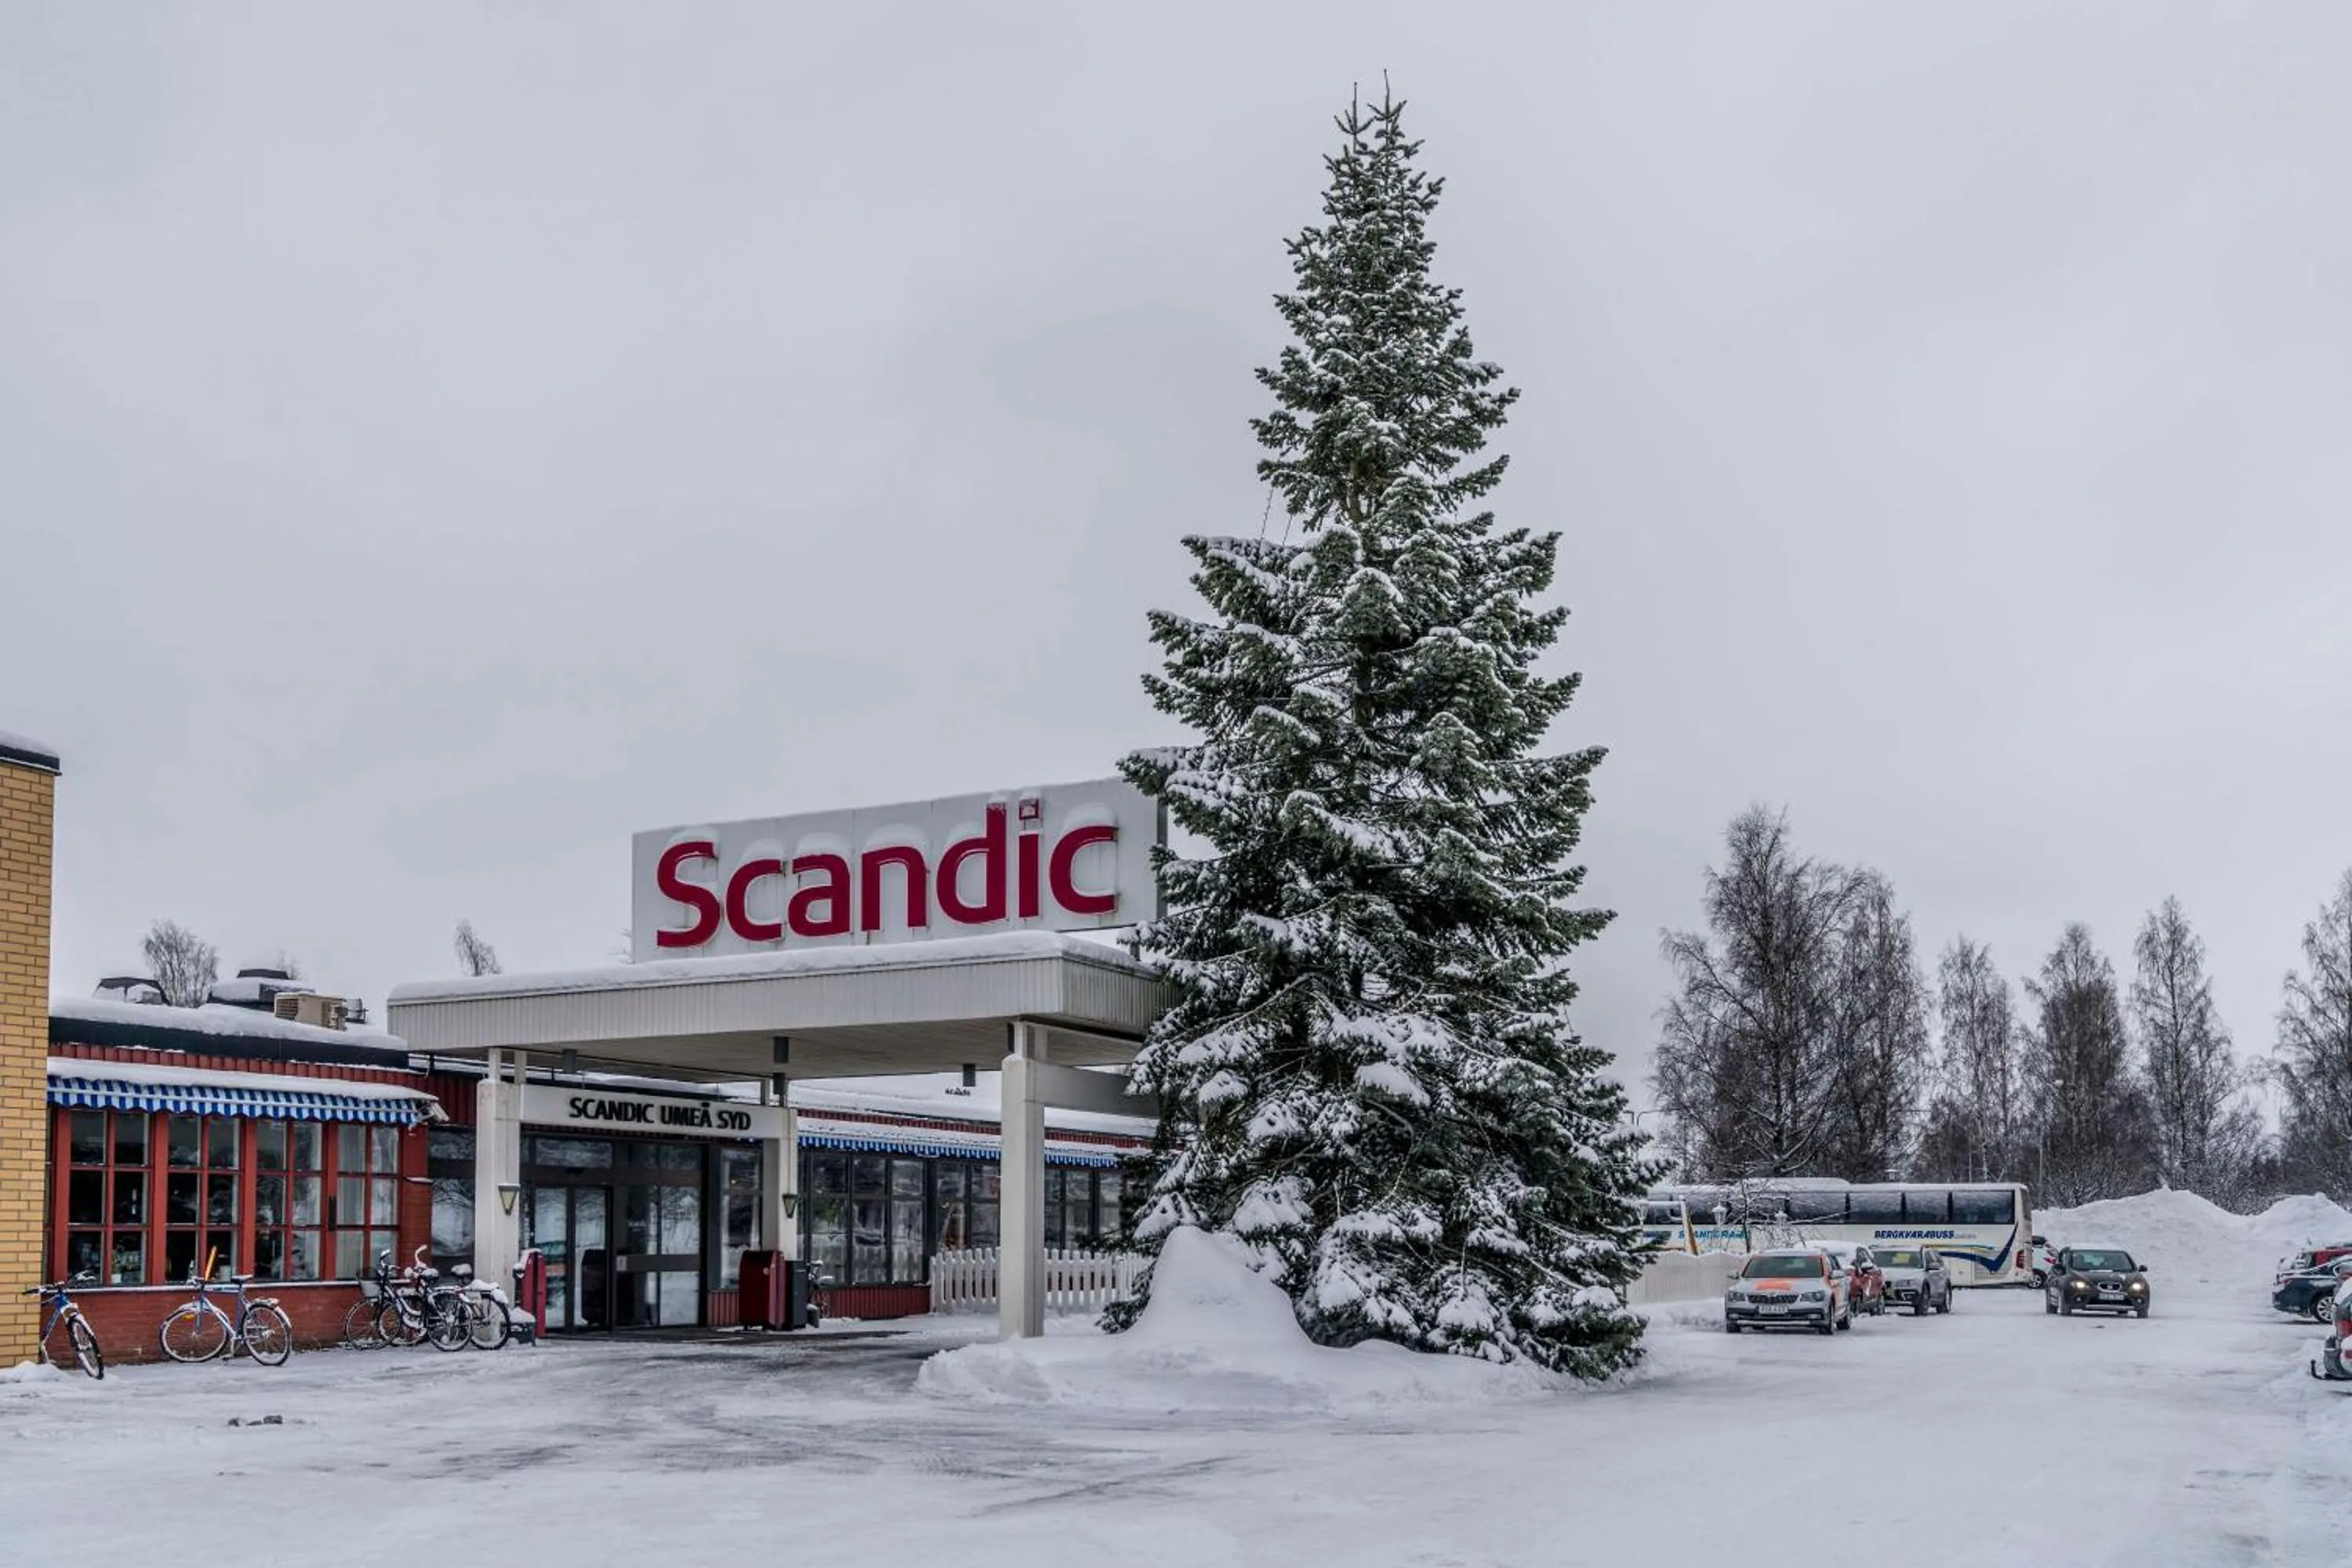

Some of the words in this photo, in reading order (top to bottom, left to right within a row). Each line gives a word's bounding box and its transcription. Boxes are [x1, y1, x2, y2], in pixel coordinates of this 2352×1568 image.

[656, 797, 1118, 948] Scandic
[569, 1097, 655, 1123] SCANDIC
[659, 1102, 713, 1128] UMEÅ
[717, 1109, 752, 1131] SYD
[1874, 1229, 1955, 1240] BERGKVARABUSS
